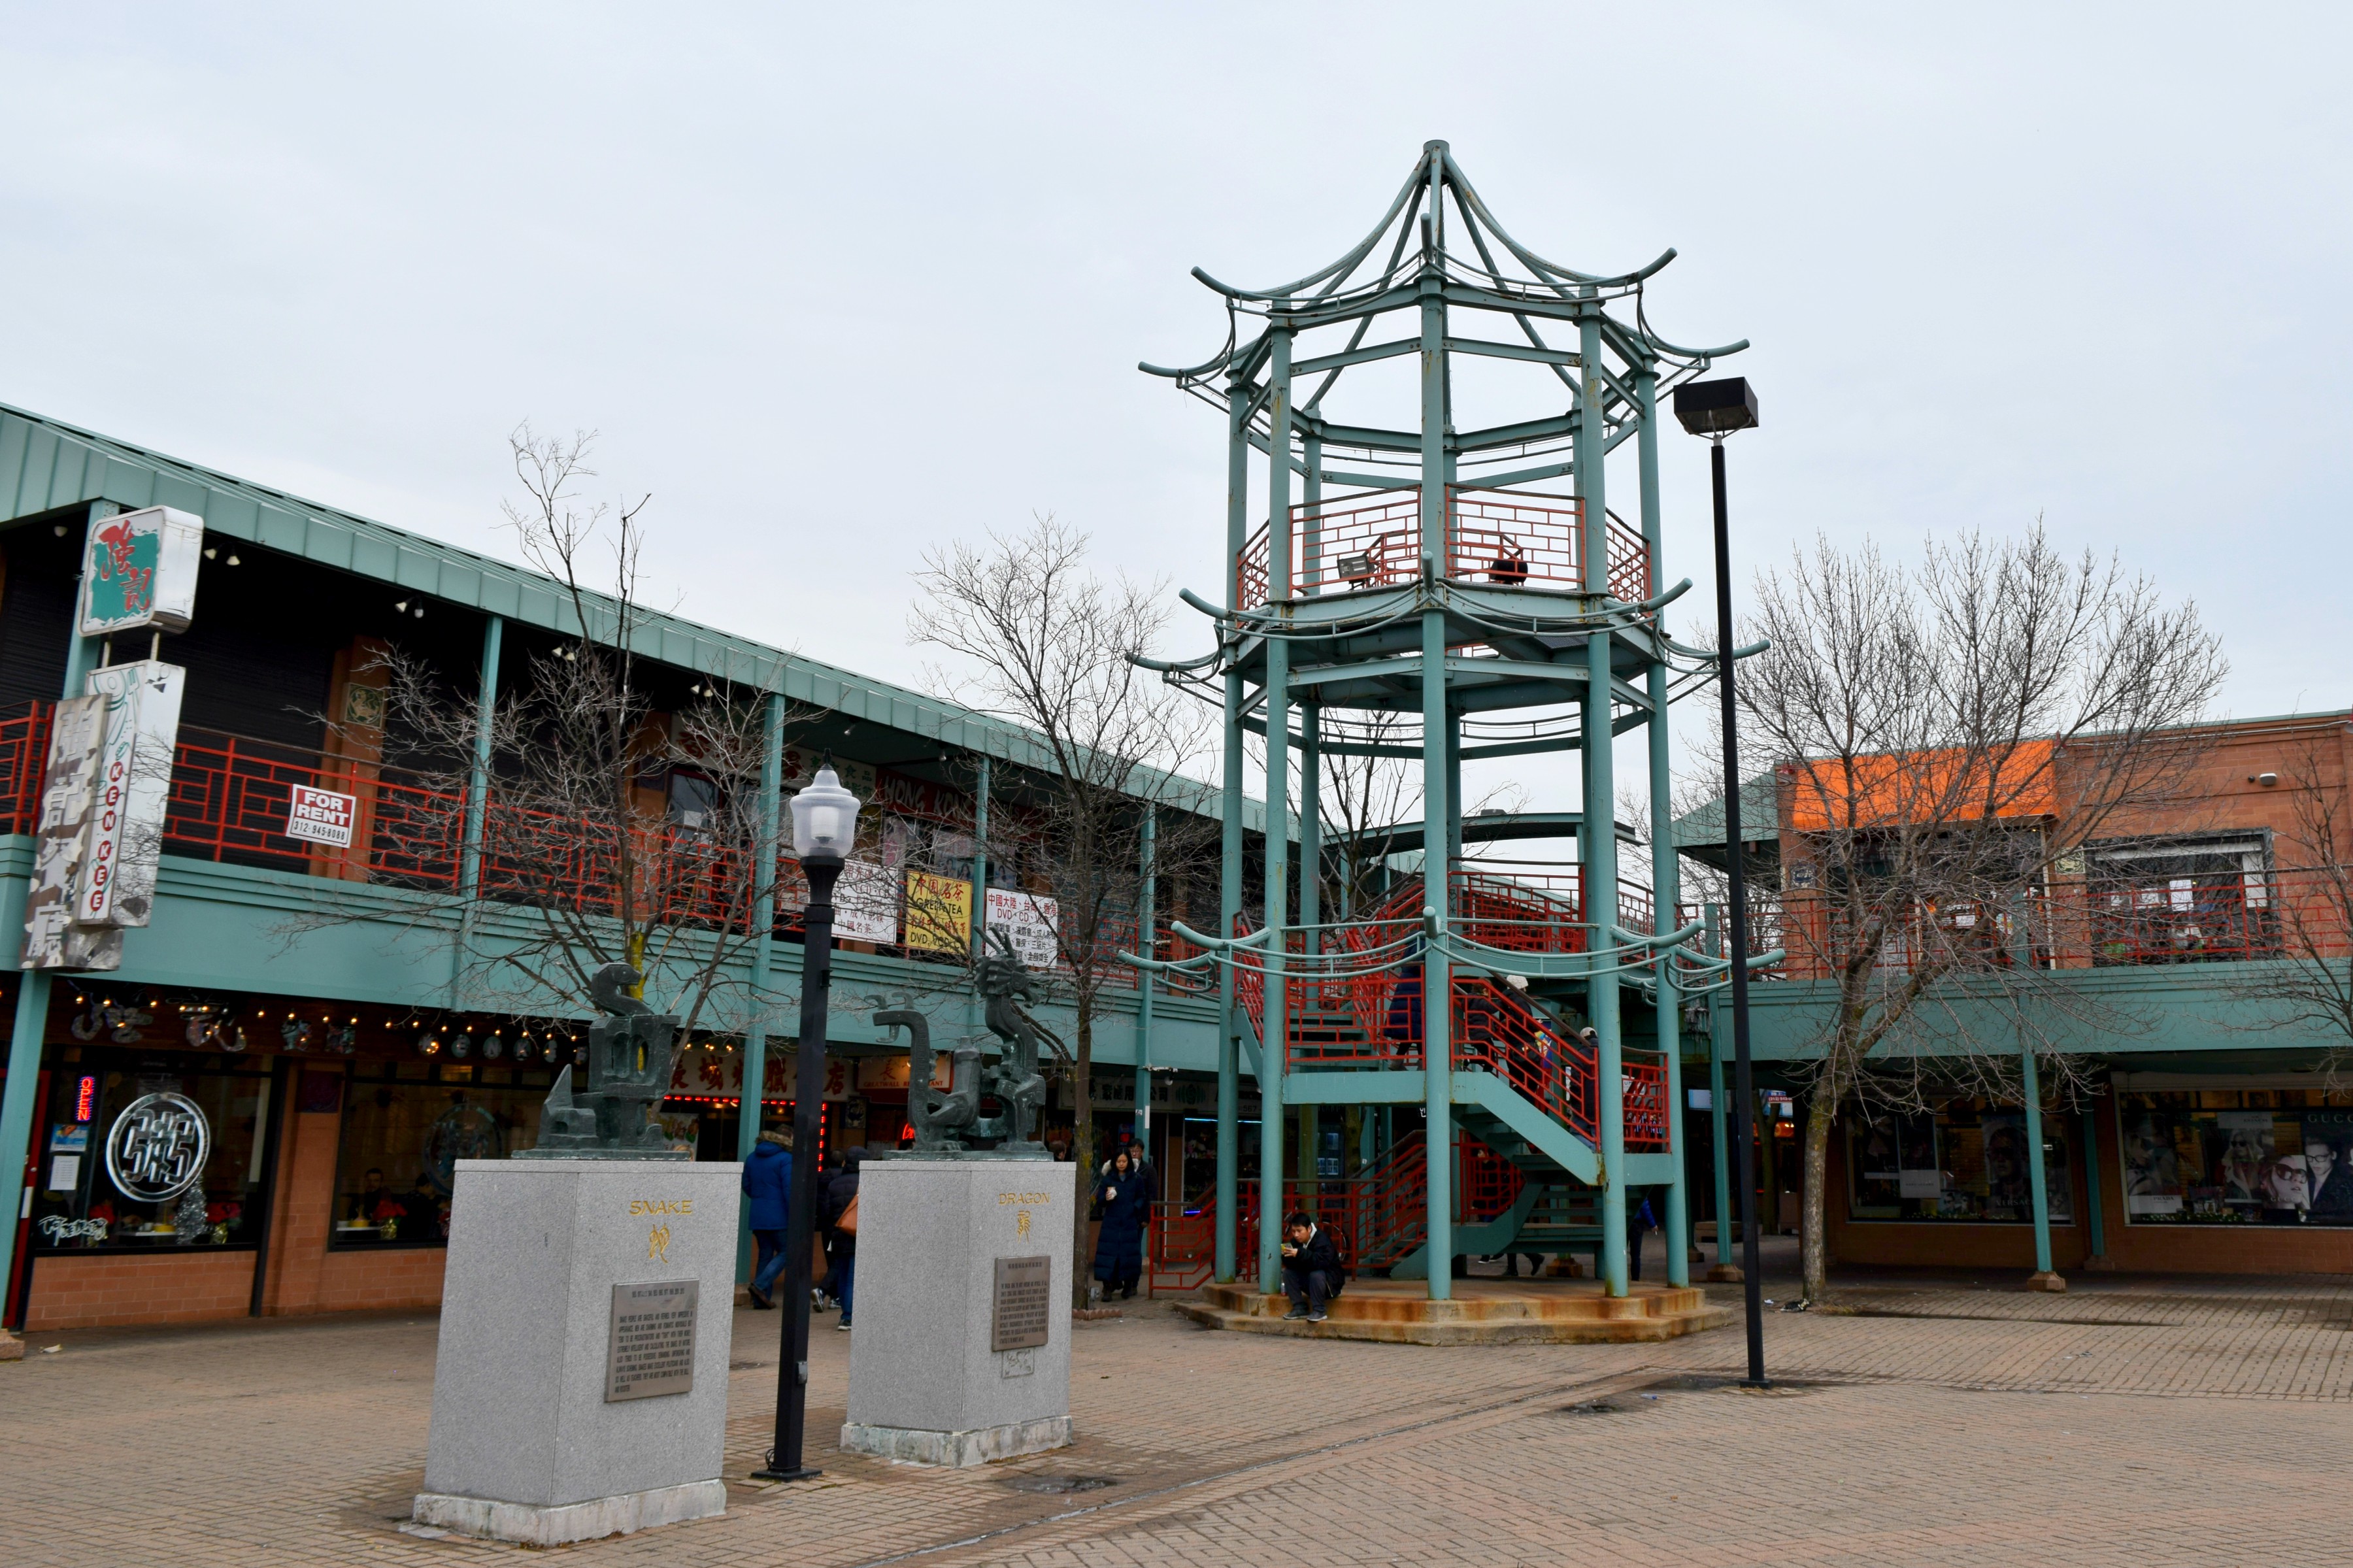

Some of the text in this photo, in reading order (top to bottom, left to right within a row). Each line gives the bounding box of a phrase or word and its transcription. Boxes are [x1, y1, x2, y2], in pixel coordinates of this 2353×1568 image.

[304, 792, 344, 811] FOR
[884, 775, 926, 813] HONG
[296, 803, 349, 826] RENT
[916, 876, 963, 901] 中國名茶
[948, 903, 963, 915] TEA
[77, 1078, 93, 1121] OPEN
[629, 1199, 694, 1216] SNAKE
[997, 1192, 1051, 1206] DRAGON
